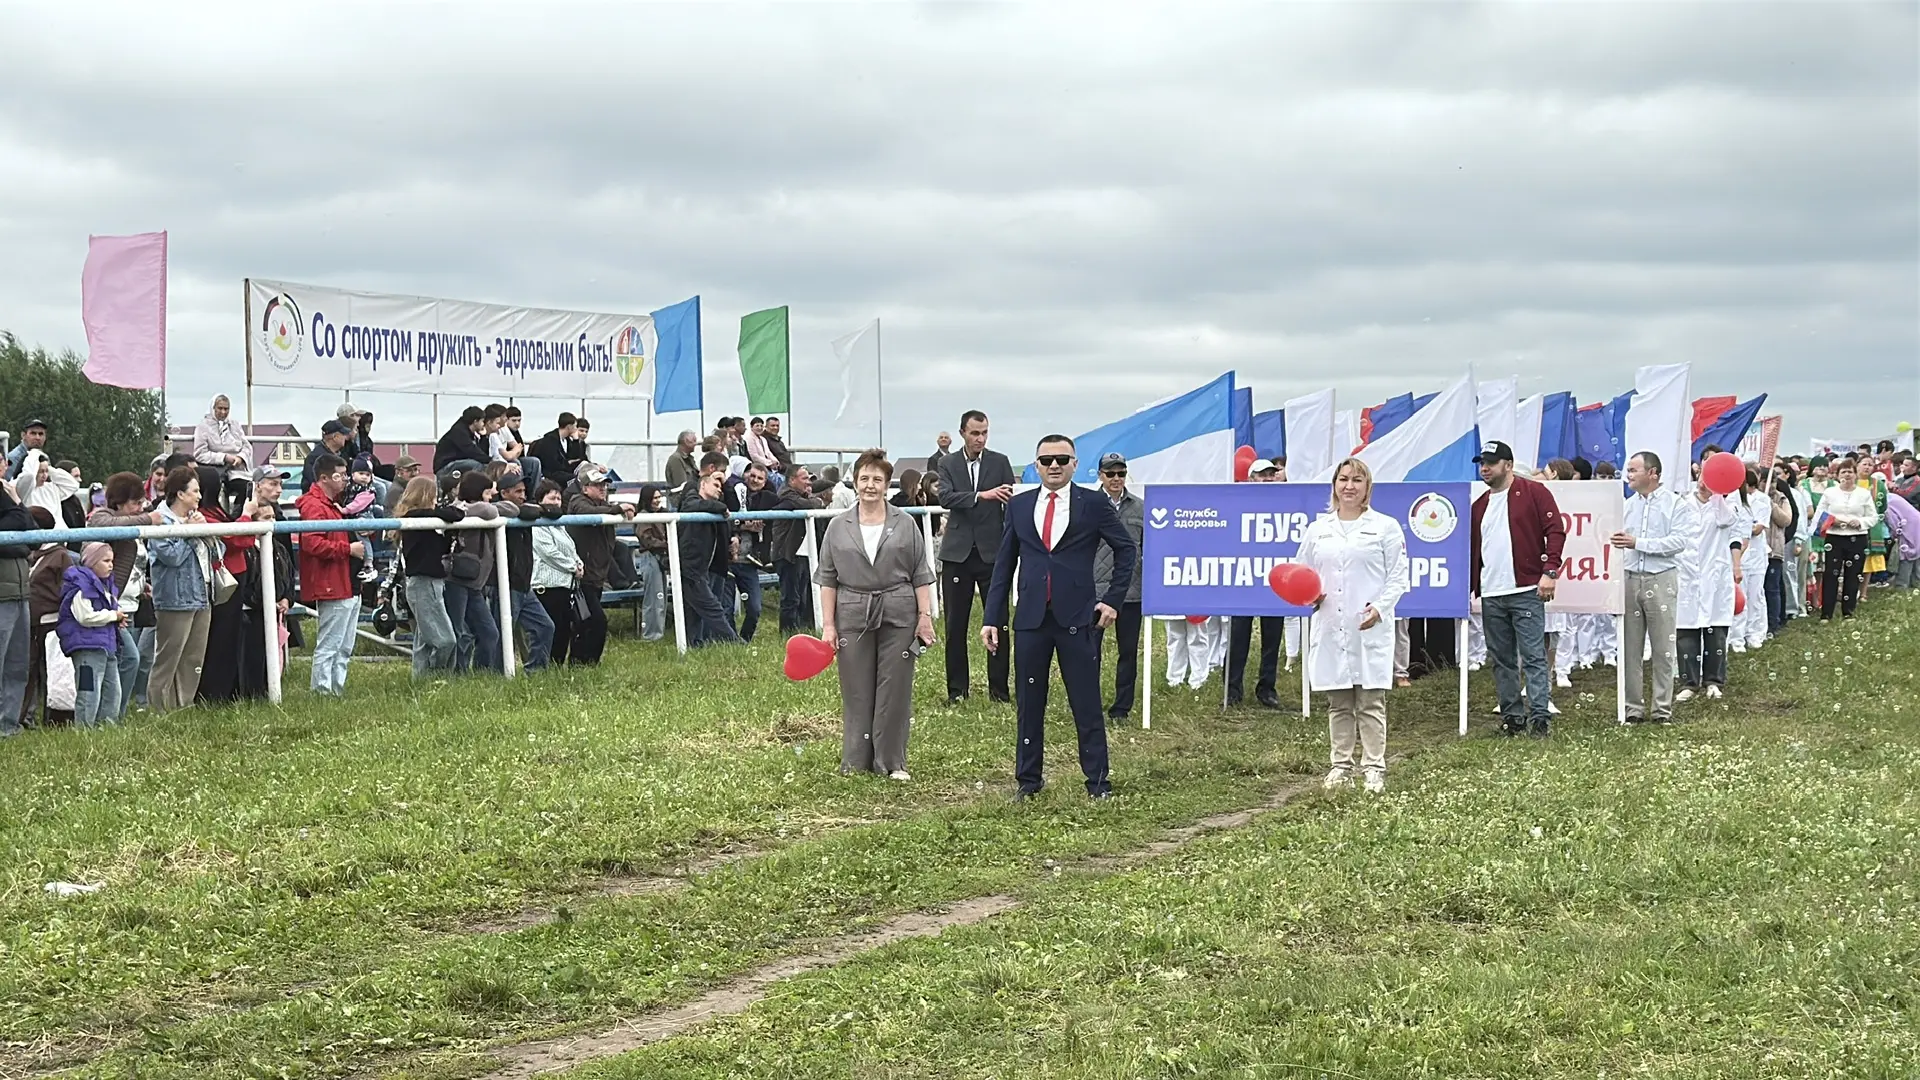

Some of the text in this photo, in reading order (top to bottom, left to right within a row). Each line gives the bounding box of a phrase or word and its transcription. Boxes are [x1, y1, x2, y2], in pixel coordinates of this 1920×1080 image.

[312, 311, 336, 358] Со
[342, 324, 412, 371] спортом
[417, 331, 482, 375] дружить
[495, 337, 574, 380] здоровыми
[578, 332, 613, 373] быть!
[1174, 508, 1218, 519] Служба
[1174, 519, 1227, 529] здоровья
[1241, 512, 1309, 543] ГБУЗ
[1163, 556, 1449, 593] БАЛТАЧ РБ
[1555, 543, 1610, 580] ия!
